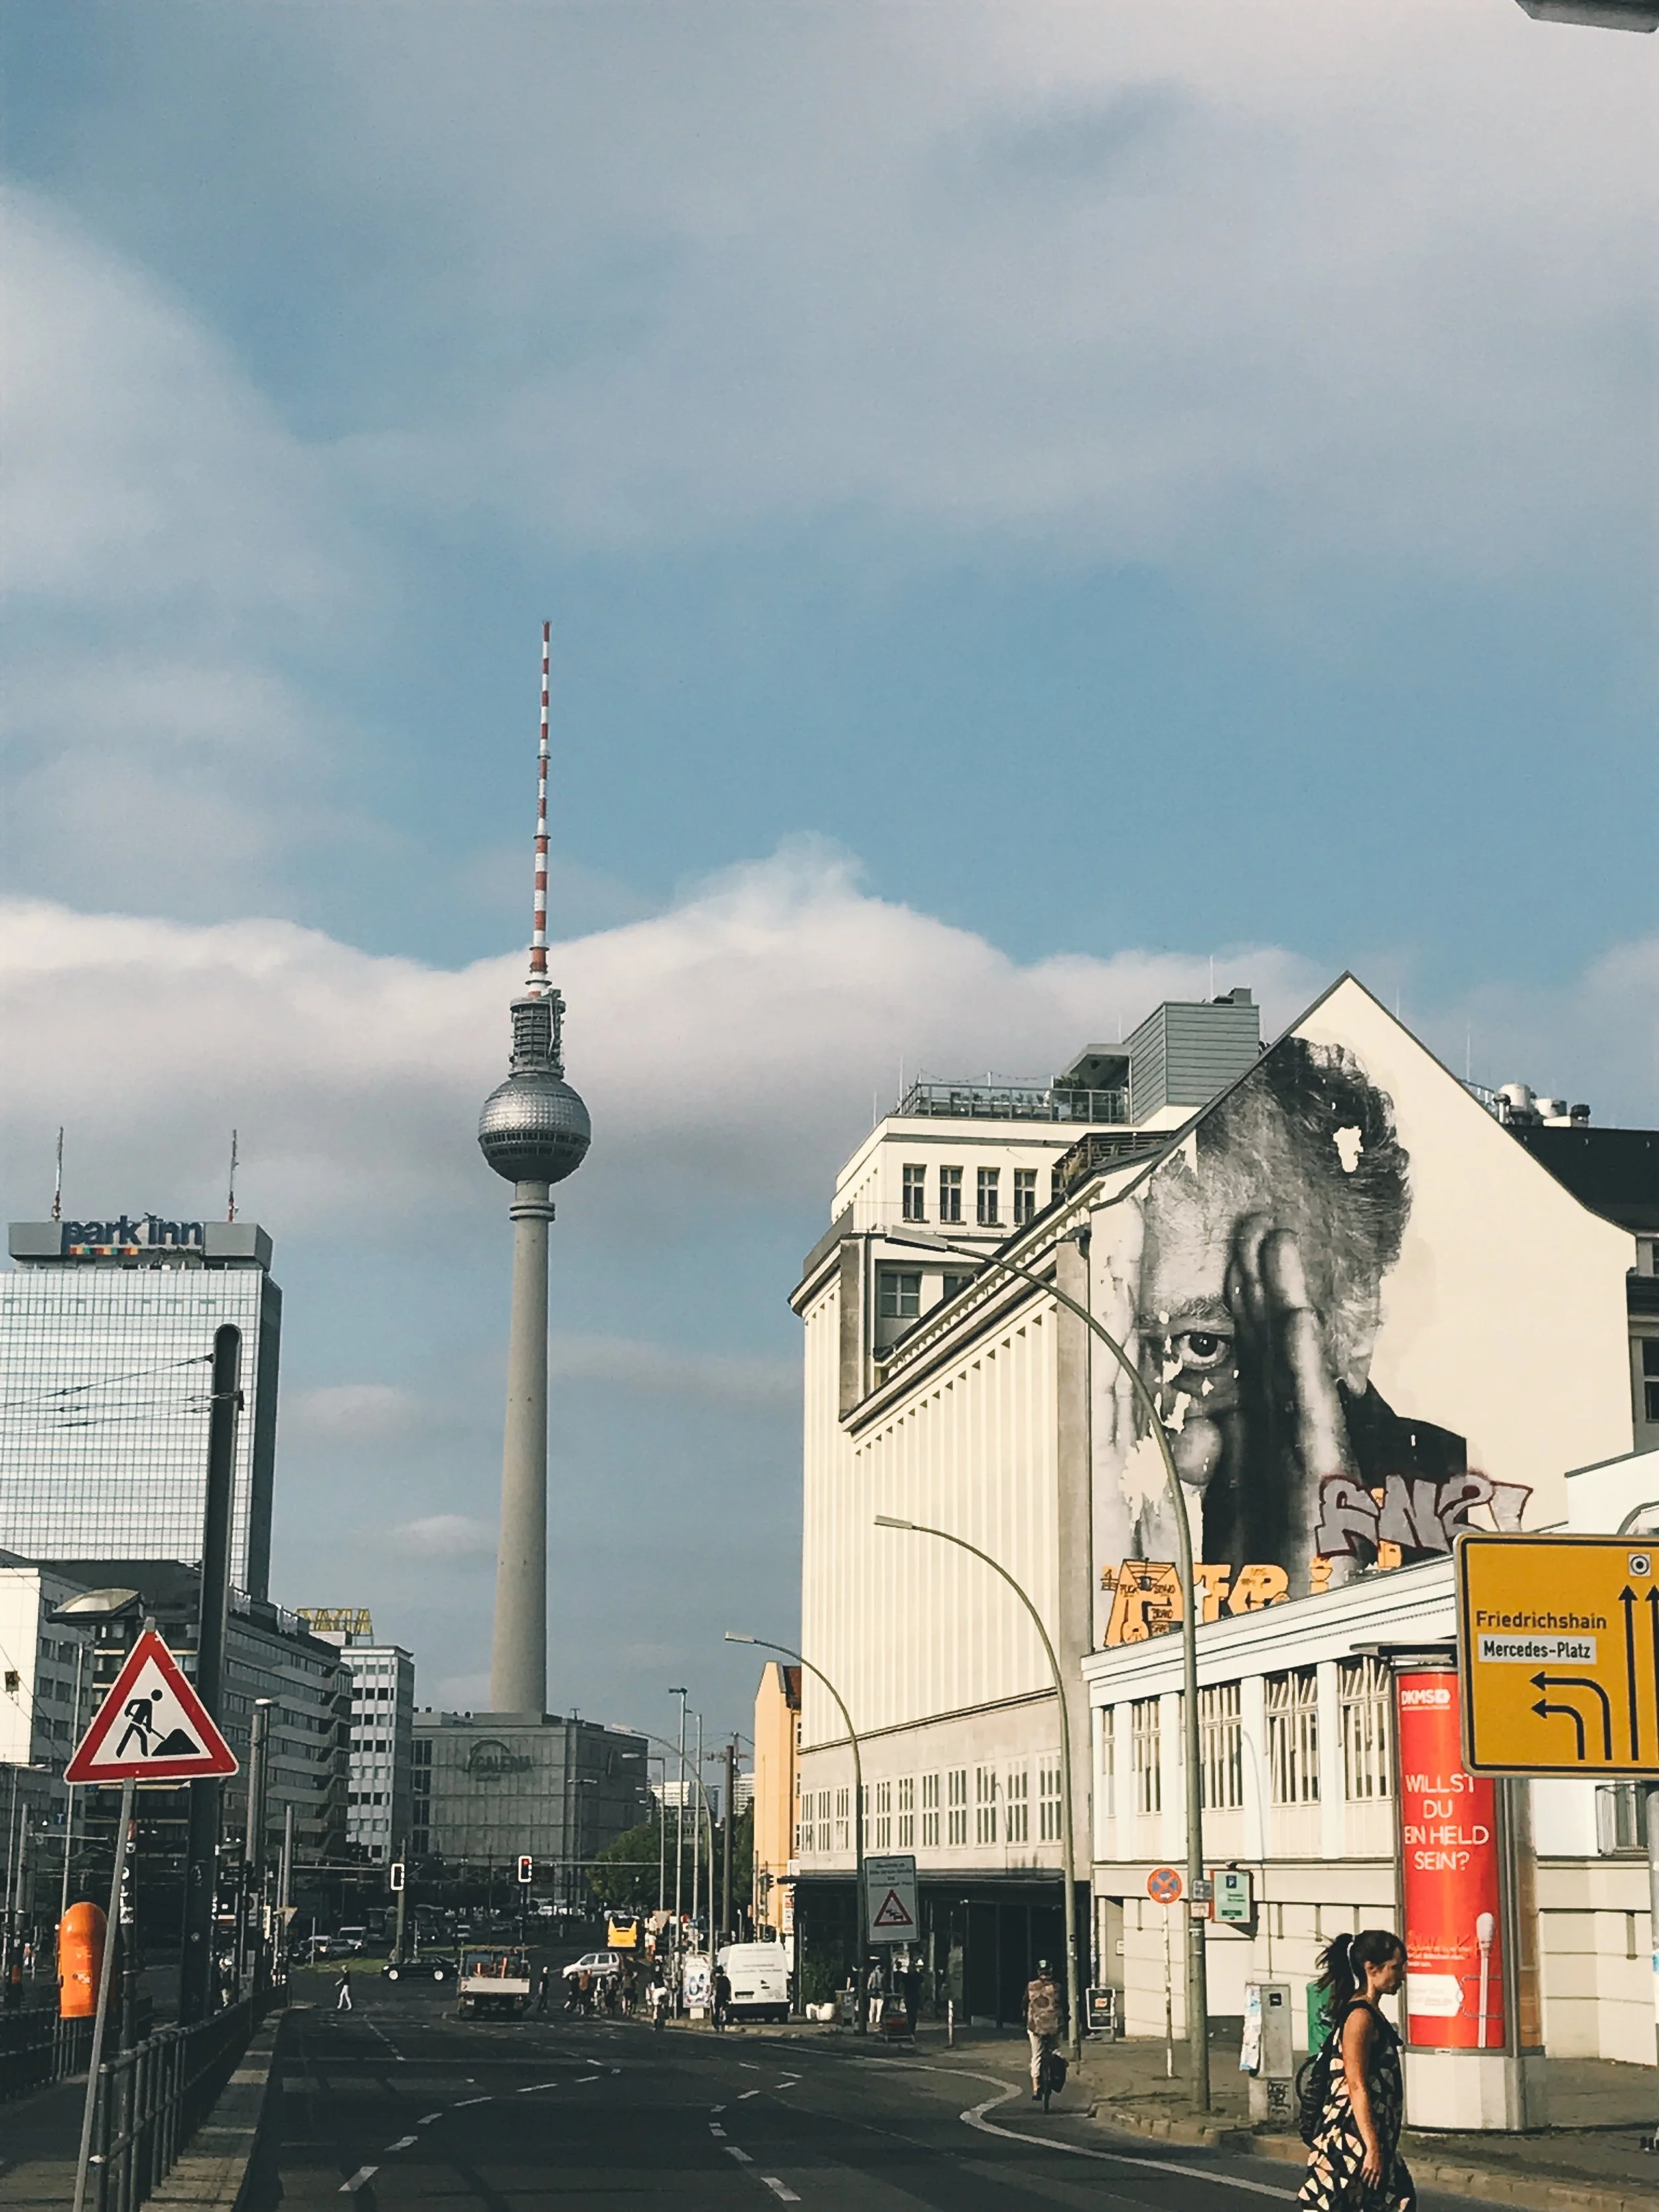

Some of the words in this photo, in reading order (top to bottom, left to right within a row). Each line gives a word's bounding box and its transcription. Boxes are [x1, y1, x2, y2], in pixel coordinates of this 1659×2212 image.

[61, 1215, 141, 1254] park
[1477, 1610, 1607, 1629] Friedrichshain
[1484, 1640, 1591, 1659] Mercedes-Platz
[1402, 1689, 1434, 1705] DKMS
[1405, 1773, 1475, 1793] WILLST
[1423, 1799, 1453, 1819] DU
[1429, 1825, 1489, 1846] HELD
[1413, 1850, 1470, 1871] SEIN?
